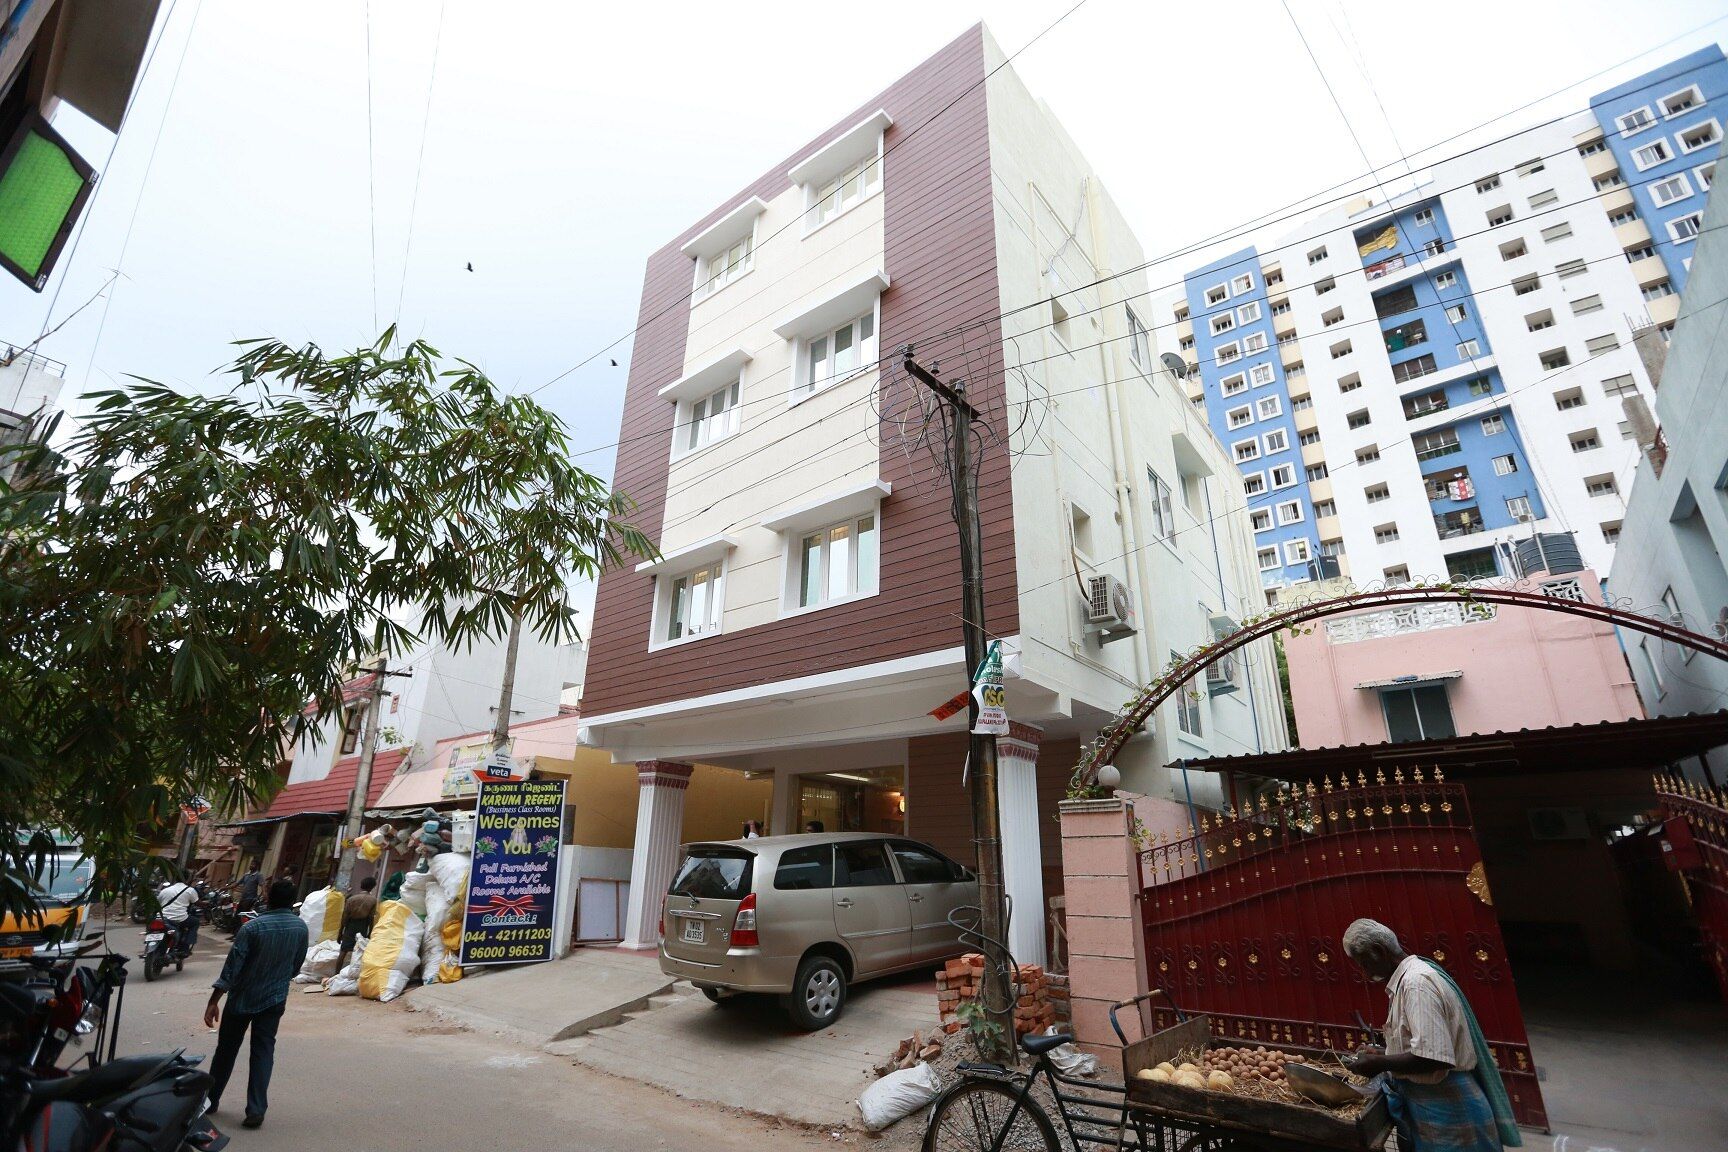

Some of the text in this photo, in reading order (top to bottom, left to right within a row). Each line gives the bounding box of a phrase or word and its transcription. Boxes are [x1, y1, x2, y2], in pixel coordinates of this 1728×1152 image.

[490, 768, 509, 777] veta
[484, 784, 517, 794] கருணா
[481, 794, 562, 806] KARUNA REGENT
[534, 805, 557, 813] Rooms)
[480, 813, 560, 829] Welcomes
[502, 839, 532, 855] You
[519, 873, 541, 884] A/C
[472, 884, 551, 896] Rooms Available
[465, 931, 487, 942] 044
[495, 928, 552, 941] 42111203
[470, 944, 544, 959] 96000 96633
